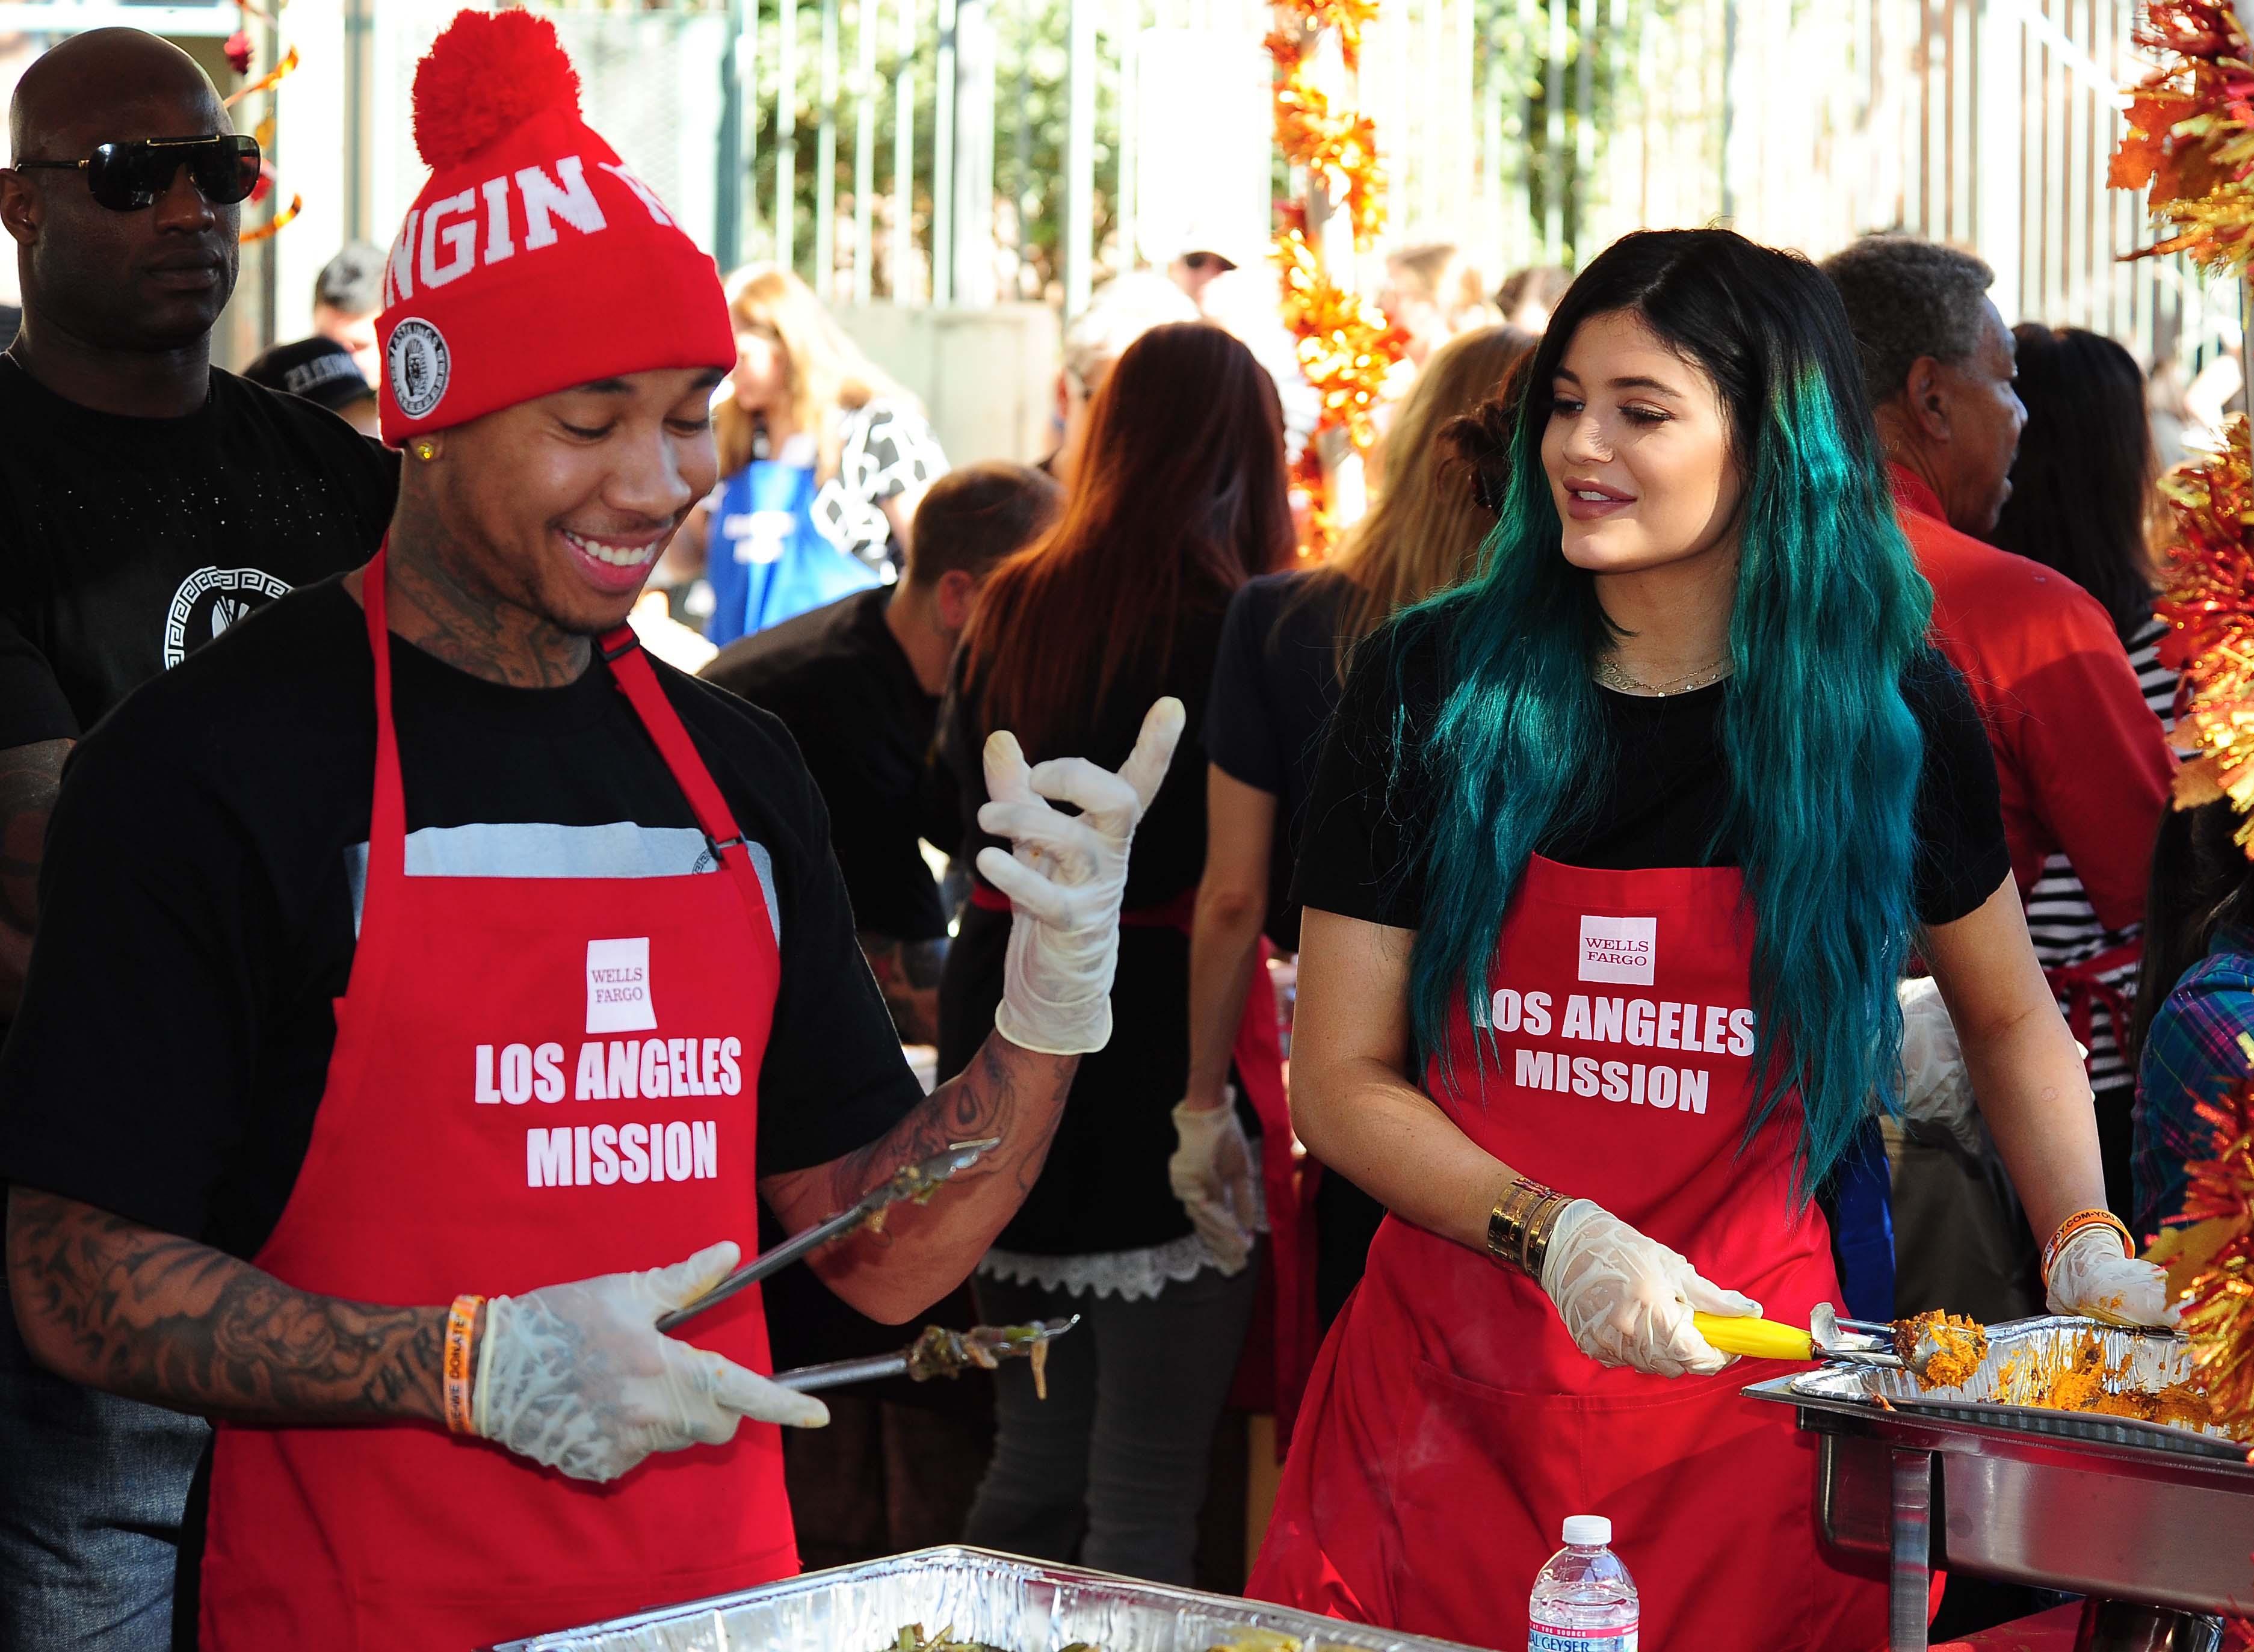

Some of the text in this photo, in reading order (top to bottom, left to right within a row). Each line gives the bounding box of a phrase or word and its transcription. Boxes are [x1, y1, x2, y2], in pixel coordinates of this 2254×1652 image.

[1585, 937, 1649, 952] WELLS
[1587, 951, 1647, 966] FARGO
[591, 967, 642, 983] WELLS
[596, 987, 643, 1003] FARGO
[1475, 988, 1755, 1056] OS ANGELES
[475, 1037, 741, 1105] LOS ANGELES
[1515, 1049, 1709, 1115] MISSION
[527, 1120, 718, 1188] MISSION
[1557, 1628, 1587, 1638] SOURCE
[1542, 1636, 1590, 1652] GEYSER
